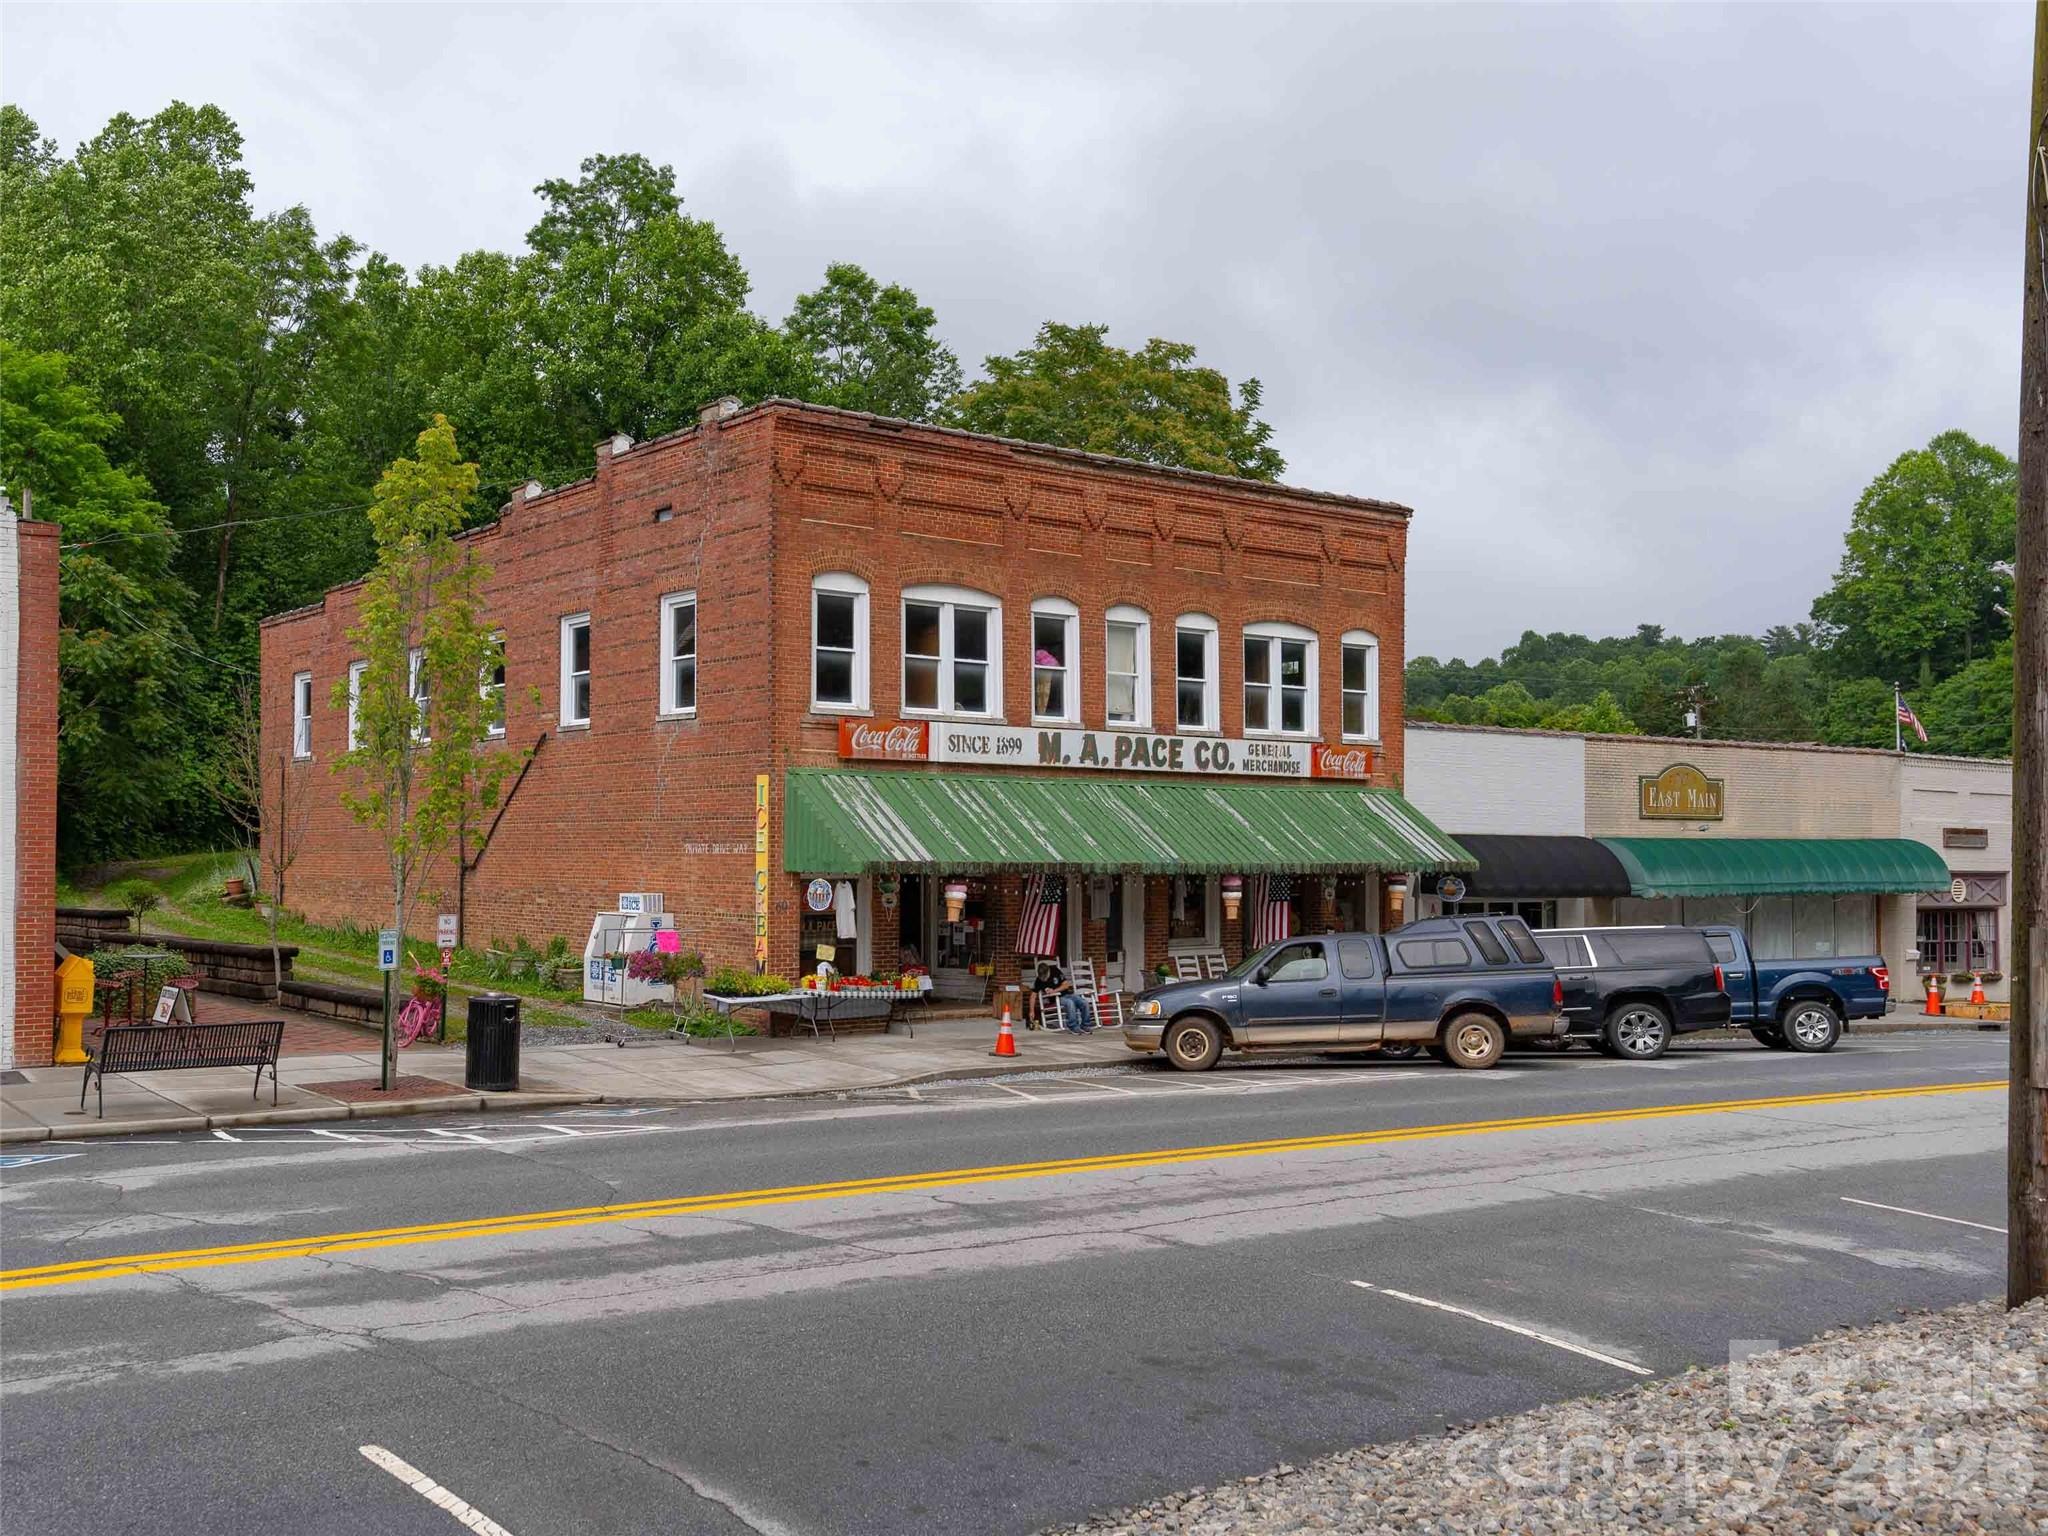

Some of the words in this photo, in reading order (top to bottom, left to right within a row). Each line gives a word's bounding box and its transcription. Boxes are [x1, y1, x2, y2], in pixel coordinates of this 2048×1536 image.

[851, 723, 921, 751] Coca-Cola
[948, 734, 990, 755] SINCE
[996, 737, 1022, 756] 1899
[1038, 731, 1071, 765] M.
[1079, 733, 1109, 766] A.
[1114, 735, 1184, 770] PACE
[1193, 740, 1235, 772] CO.
[1242, 758, 1301, 775] MERCHANDISE
[629, 900, 641, 911] ICE
